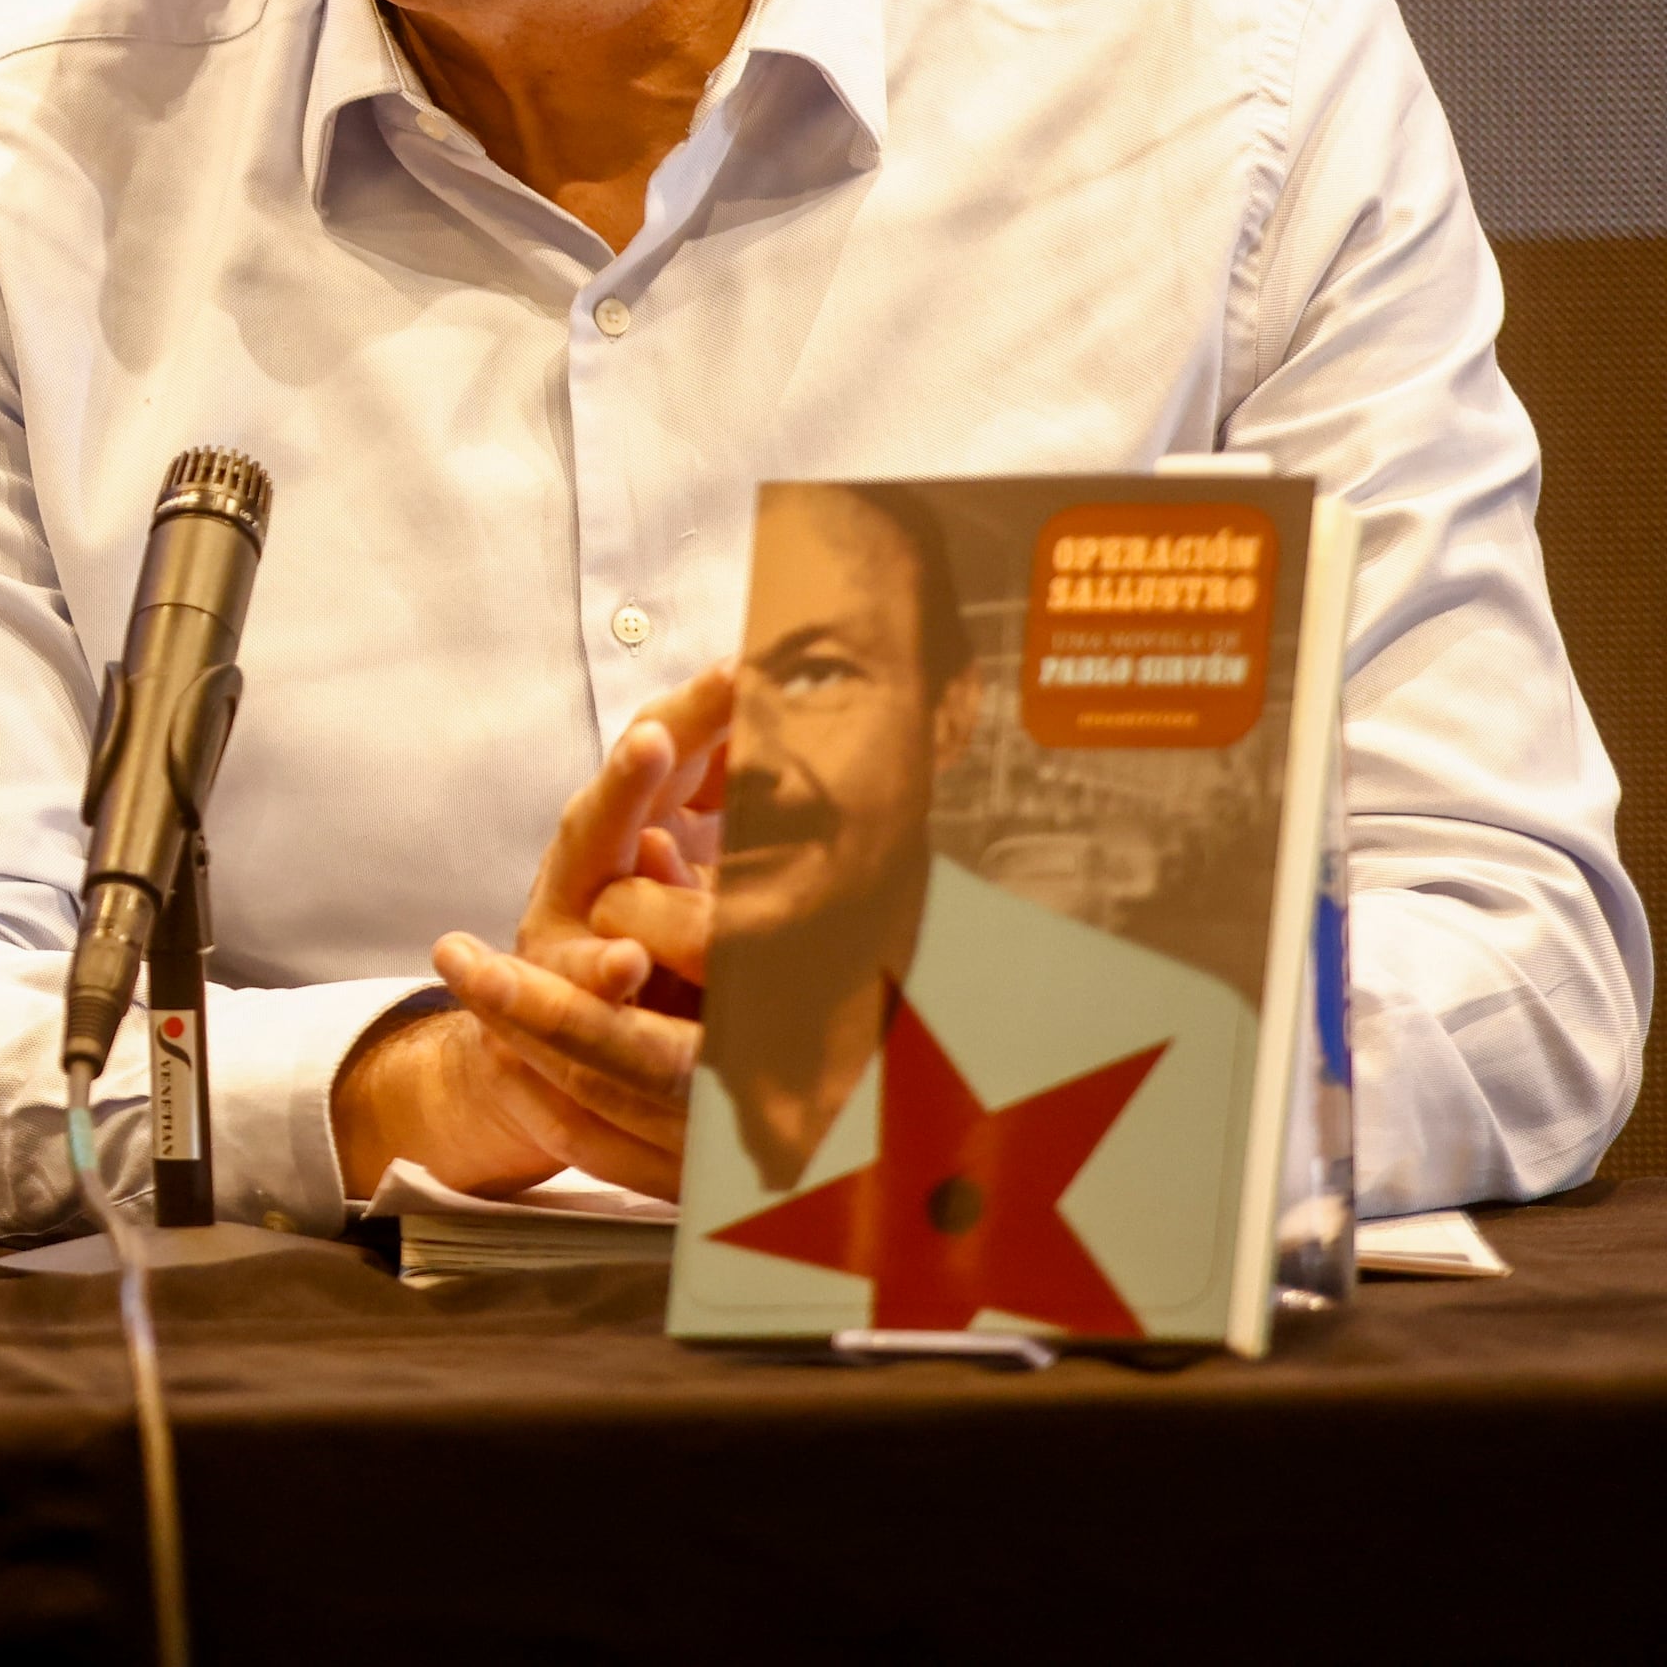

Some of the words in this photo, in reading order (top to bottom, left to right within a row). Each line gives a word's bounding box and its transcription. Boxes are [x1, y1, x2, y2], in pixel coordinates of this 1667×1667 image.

[1052, 528, 1260, 571] OPERACIÓN
[1047, 575, 1257, 613] SALLUSTRO
[1039, 655, 1133, 687] PABLO
[160, 1060, 174, 1156] VENETIAN
